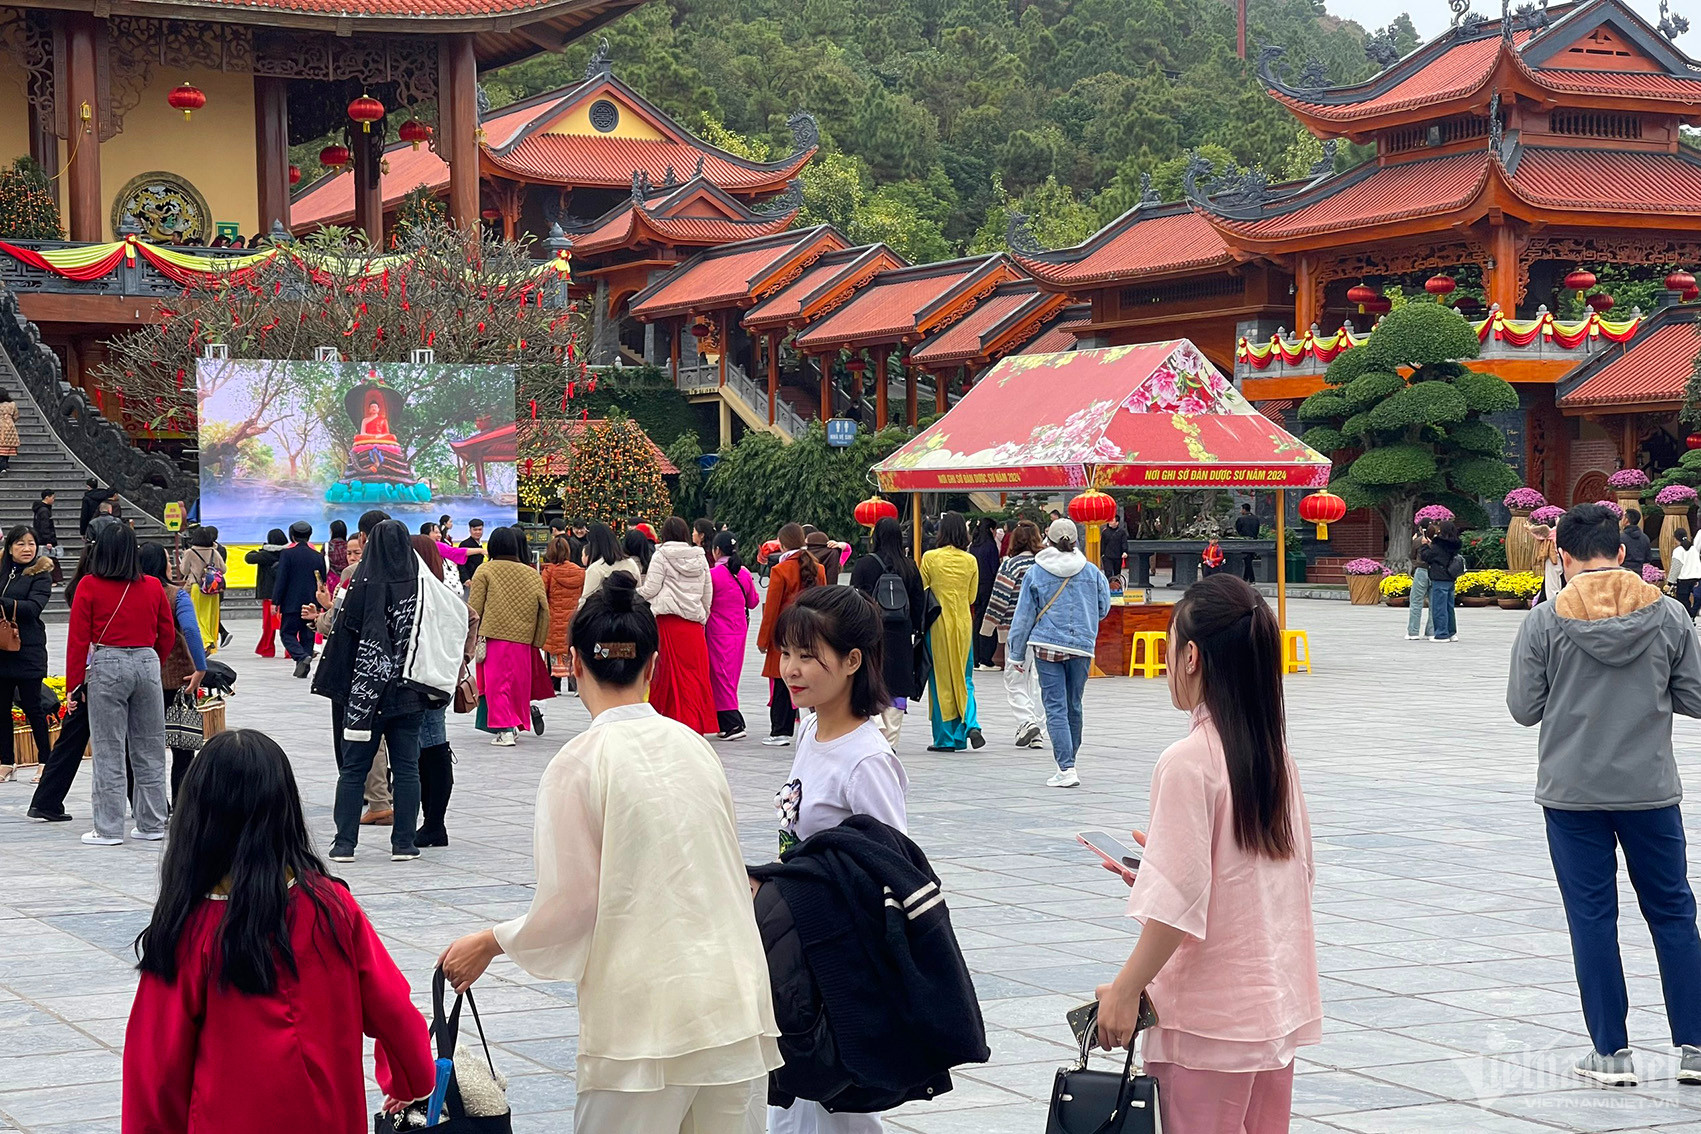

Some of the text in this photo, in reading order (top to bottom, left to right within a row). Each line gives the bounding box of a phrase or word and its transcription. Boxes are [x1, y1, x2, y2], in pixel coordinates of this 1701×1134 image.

[1145, 469, 1160, 480] NƠI
[1161, 470, 1176, 480] GHI
[1177, 468, 1190, 480] SỚ
[1209, 469, 1232, 482] DƯỢC
[1233, 469, 1246, 480] SƯ
[1246, 468, 1266, 480] NĂM
[1267, 470, 1287, 480] 2024
